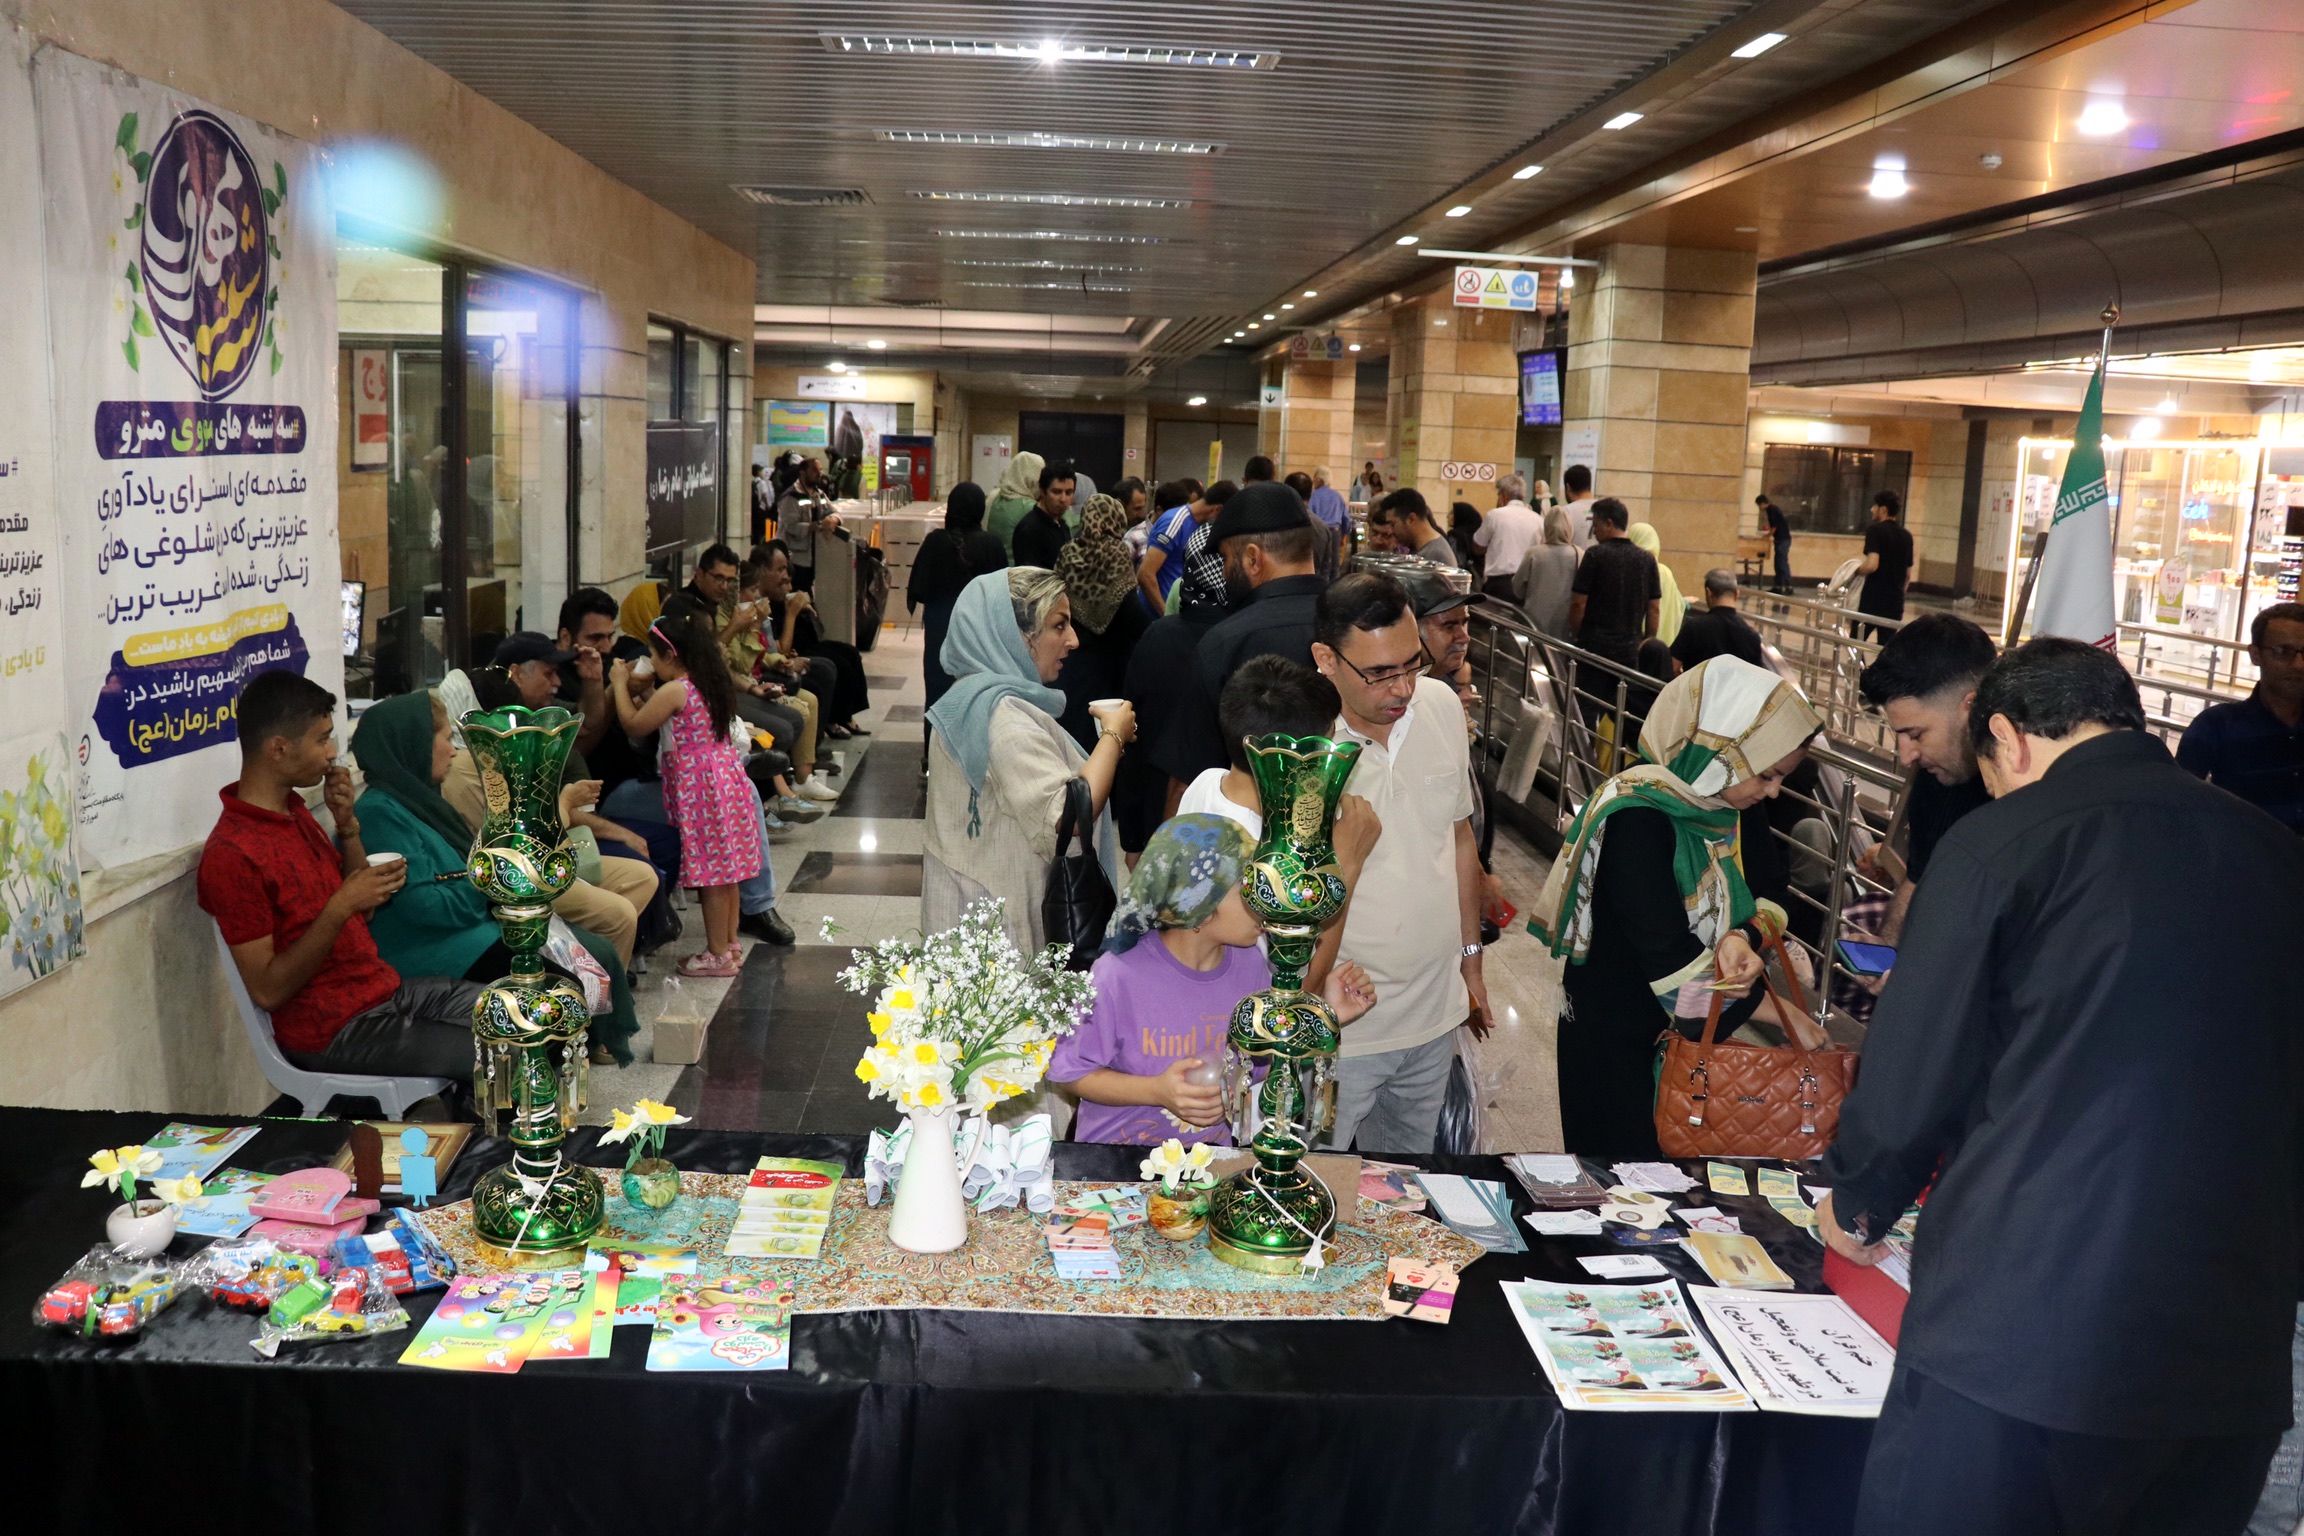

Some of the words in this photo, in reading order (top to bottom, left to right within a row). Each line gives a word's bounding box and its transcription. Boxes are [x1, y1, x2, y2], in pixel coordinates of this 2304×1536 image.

[118, 410, 166, 453] مترو
[214, 406, 242, 450] های
[247, 409, 274, 448] شنبه
[234, 471, 250, 506] ای
[657, 467, 670, 502] رضا
[134, 522, 215, 568] شلوغی
[231, 516, 246, 544] که
[231, 560, 257, 590] شده
[159, 571, 223, 616] غریب
[249, 651, 268, 672] هم
[269, 639, 291, 662] شما
[150, 672, 195, 704] باشید
[1142, 1025, 1197, 1057] Kind
[1759, 1307, 1799, 1332] تعجیل
[1788, 1338, 1830, 1368] سلامتی
[1821, 1327, 1861, 1350] قرآن
[1757, 1348, 1792, 1365] امام
[1775, 1366, 1815, 1389] ظهور
[1825, 1367, 1849, 1386] نیت
[1796, 1388, 1823, 1399] در
